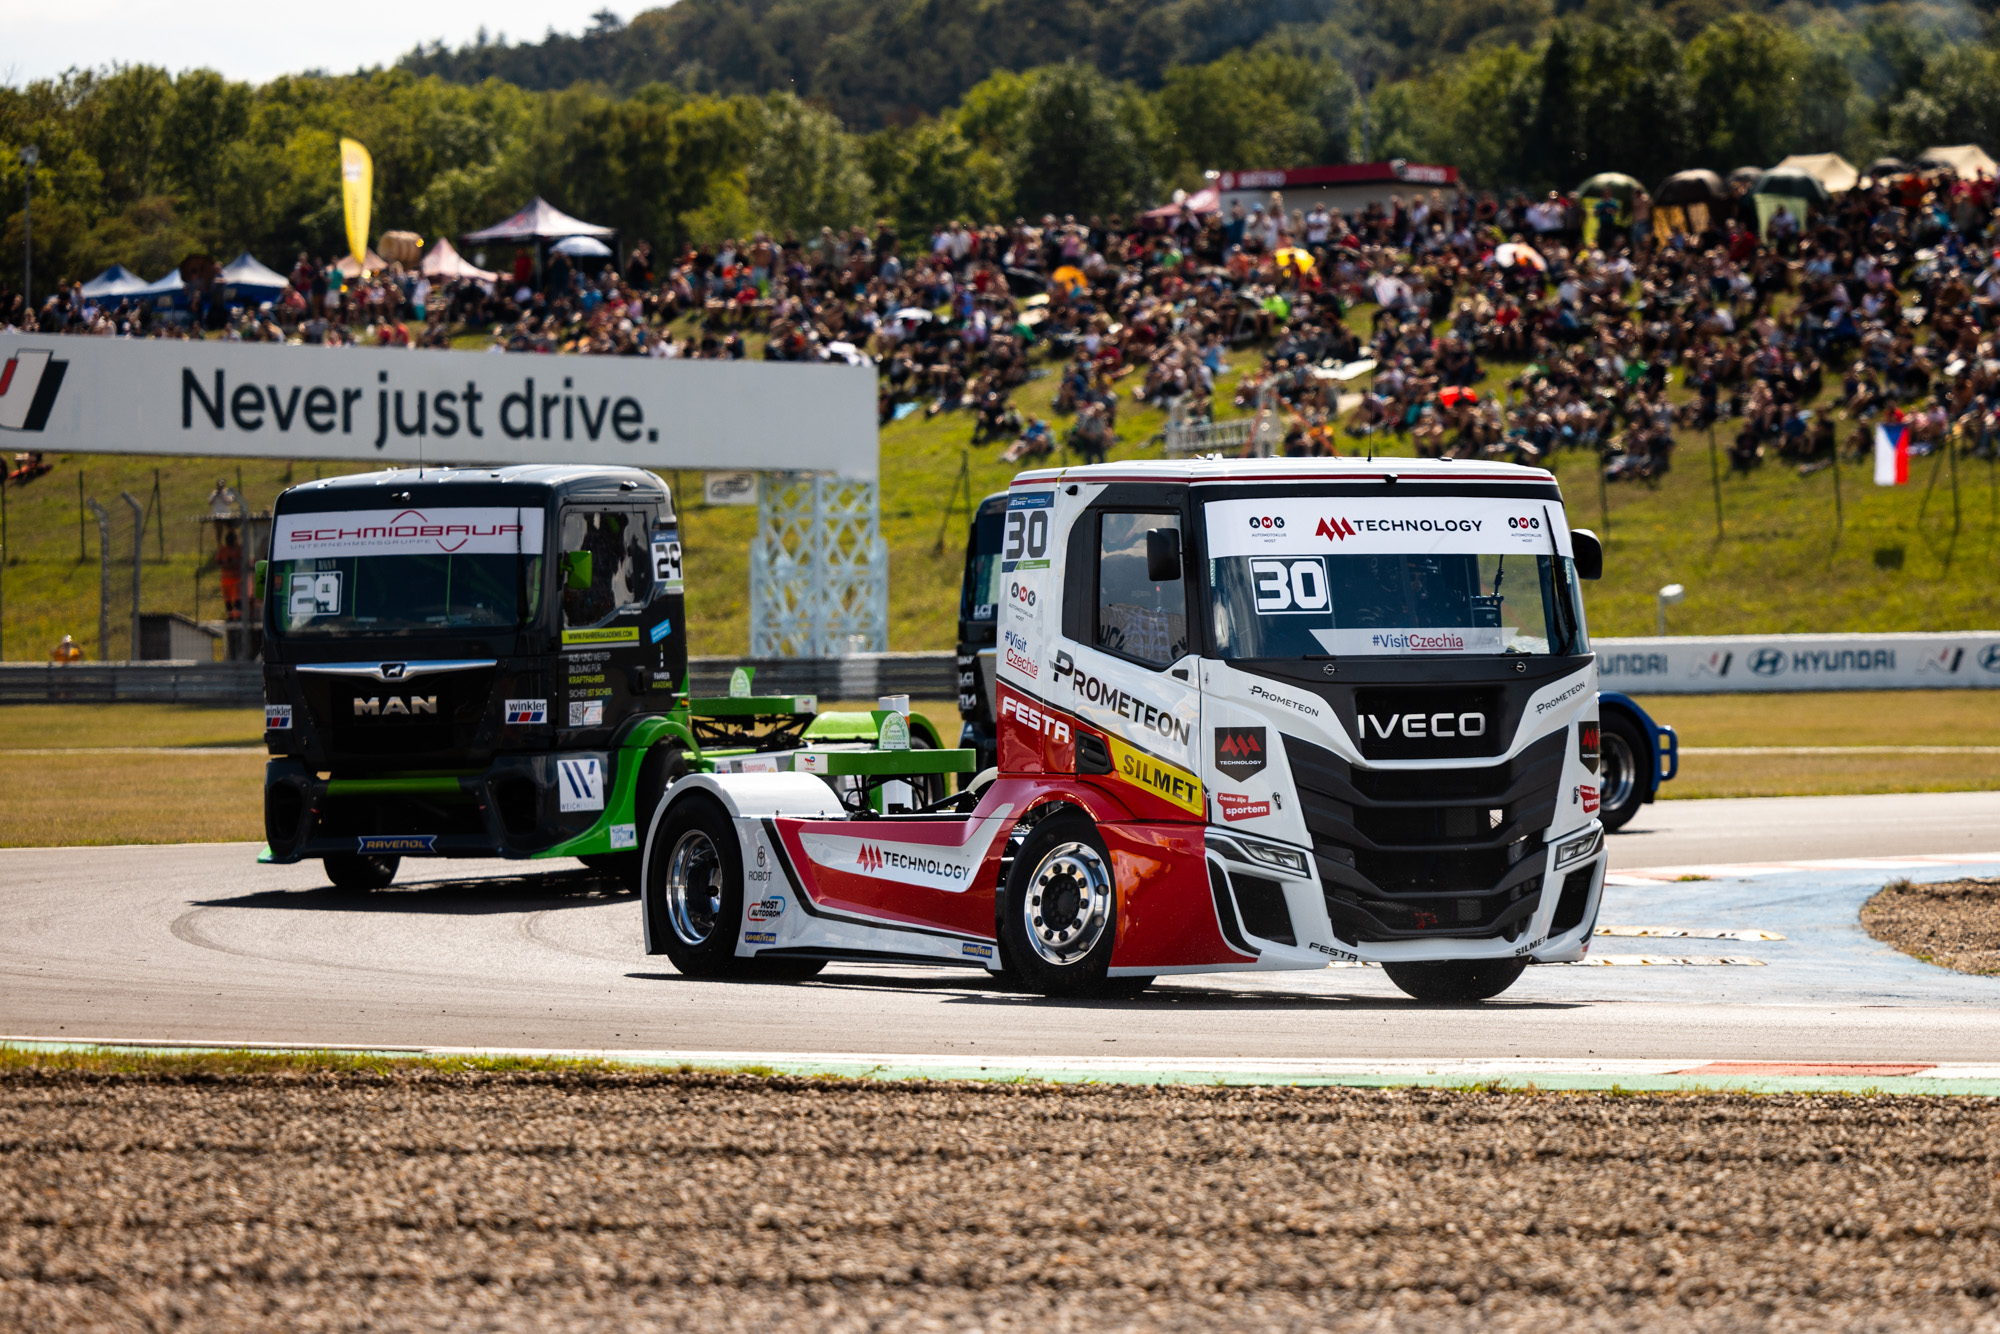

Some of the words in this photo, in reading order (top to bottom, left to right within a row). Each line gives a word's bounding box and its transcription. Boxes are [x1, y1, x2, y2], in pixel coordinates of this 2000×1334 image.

[182, 367, 362, 433] Never
[374, 370, 484, 450] just
[500, 376, 659, 444] drive.
[1250, 517, 1285, 529] AMK
[1353, 519, 1482, 532] TECHNOLOGY
[1508, 517, 1539, 529] AMK
[1006, 510, 1048, 560] 30
[290, 539, 431, 550] UNTERNEHMENSGRUPPE
[655, 543, 681, 579] 29
[291, 574, 339, 614] 29
[1011, 582, 1036, 606] AMK
[1252, 561, 1328, 610] 30
[568, 629, 633, 641] WWW.FAHRERAKADEMIE.COM
[1005, 629, 1027, 653] #Visit
[1372, 633, 1464, 648] #VisitCzechia
[568, 664, 591, 674] BILDUNG
[1006, 648, 1039, 676] Czechia
[1598, 653, 1668, 676] UNDAI
[1793, 649, 1896, 673] HYUNDAI
[568, 674, 605, 685] KRAFTFAHRER
[653, 671, 671, 680] FAHRER
[568, 688, 587, 698] SICHER
[587, 688, 595, 697] IST
[652, 680, 673, 689] AKADEMIE
[354, 696, 437, 715] MAN
[509, 700, 546, 711] winkler
[1050, 650, 1190, 747] PROMETEON
[1249, 685, 1319, 717] PROMETEON
[1536, 681, 1586, 714] PROMETEON
[1002, 696, 1070, 743] FESTA
[1357, 712, 1486, 739] IVECO
[744, 762, 767, 772] Sponsors
[1123, 754, 1197, 803] SILMET
[1226, 805, 1267, 816] sportem
[366, 840, 426, 850] RAVENOL
[883, 851, 971, 881] TECHNOLOGY
[749, 871, 772, 882] ROBOT
[751, 908, 781, 918] AUTODROM
[760, 900, 779, 910] MOST
[746, 933, 776, 943] GOODYEAR
[1515, 935, 1547, 957] SILMET
[963, 945, 992, 957] GOODYEAR
[1309, 942, 1358, 962] FESTA
